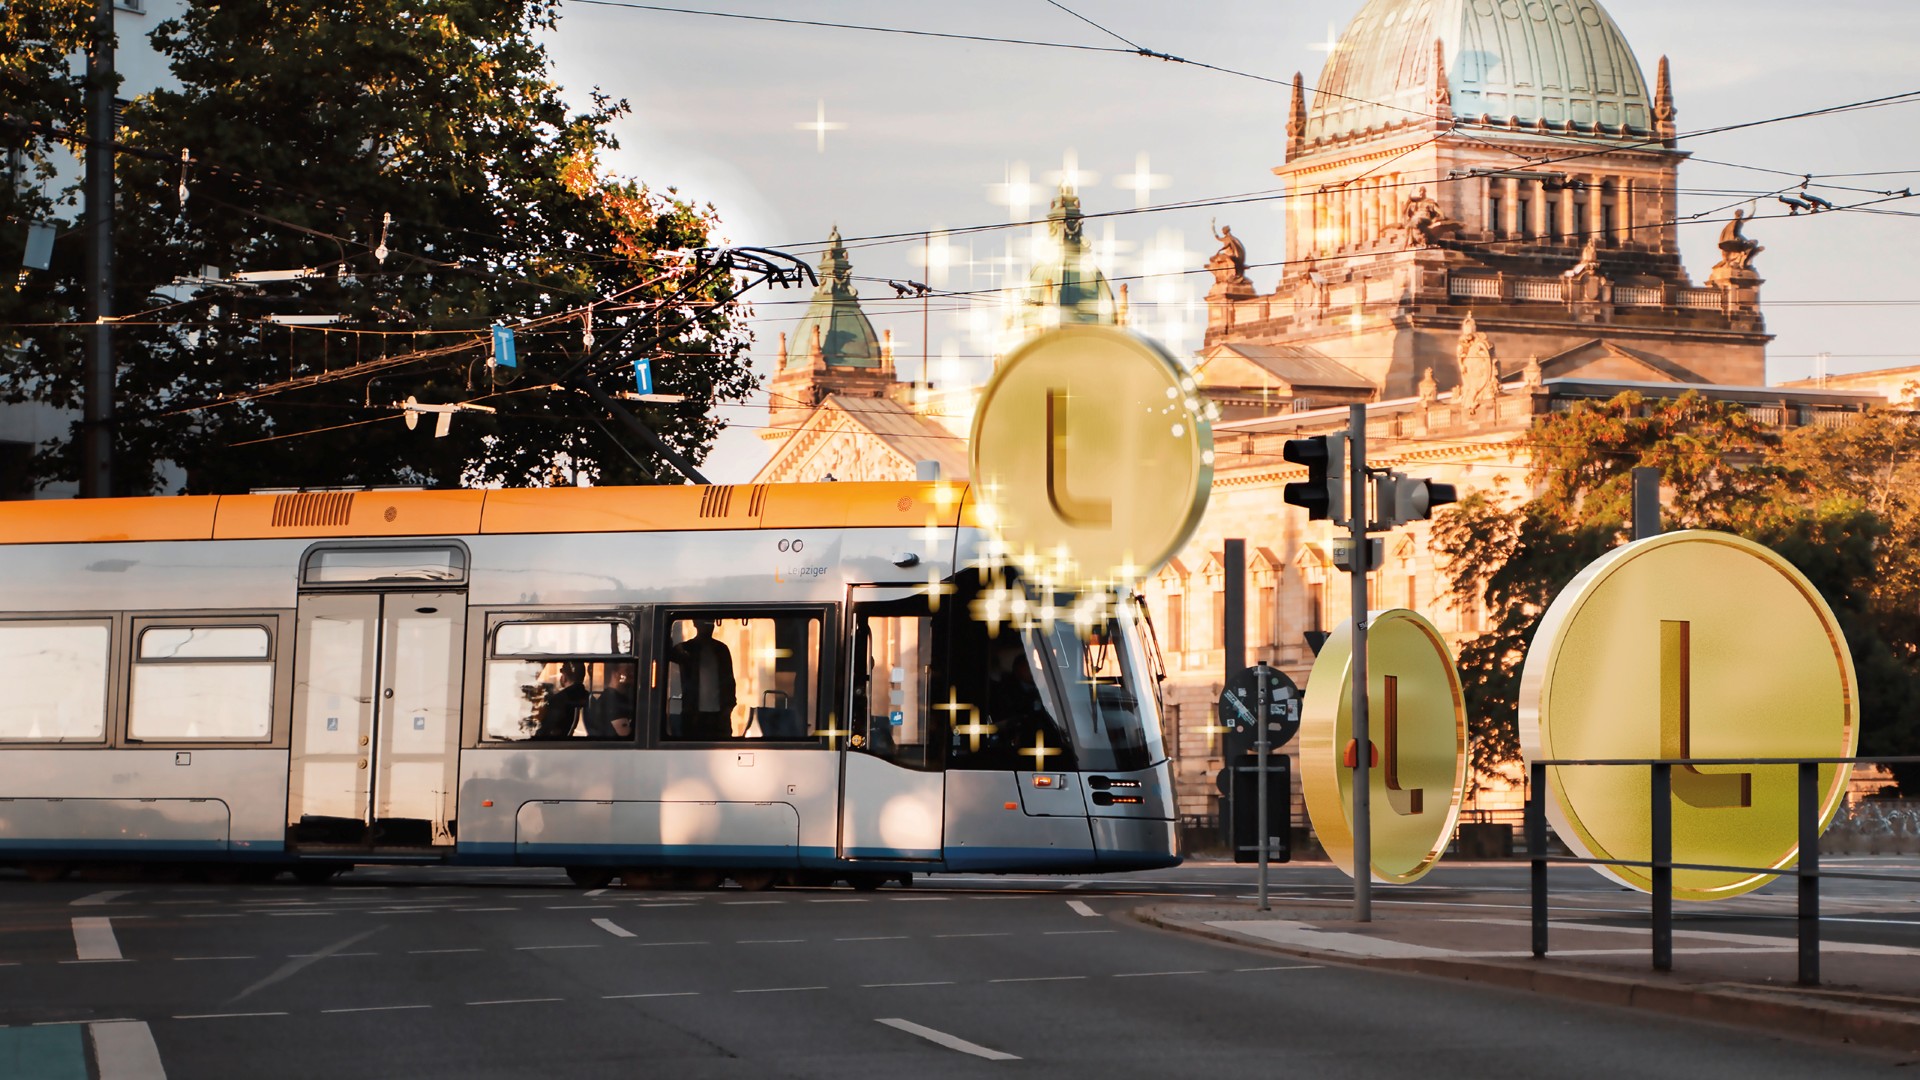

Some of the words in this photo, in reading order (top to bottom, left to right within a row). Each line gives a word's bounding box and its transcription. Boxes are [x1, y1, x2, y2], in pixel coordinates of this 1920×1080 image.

[498, 331, 509, 361] T
[638, 363, 647, 390] T
[1046, 386, 1113, 530] L
[1384, 674, 1424, 816] L
[1659, 619, 1752, 809] L
